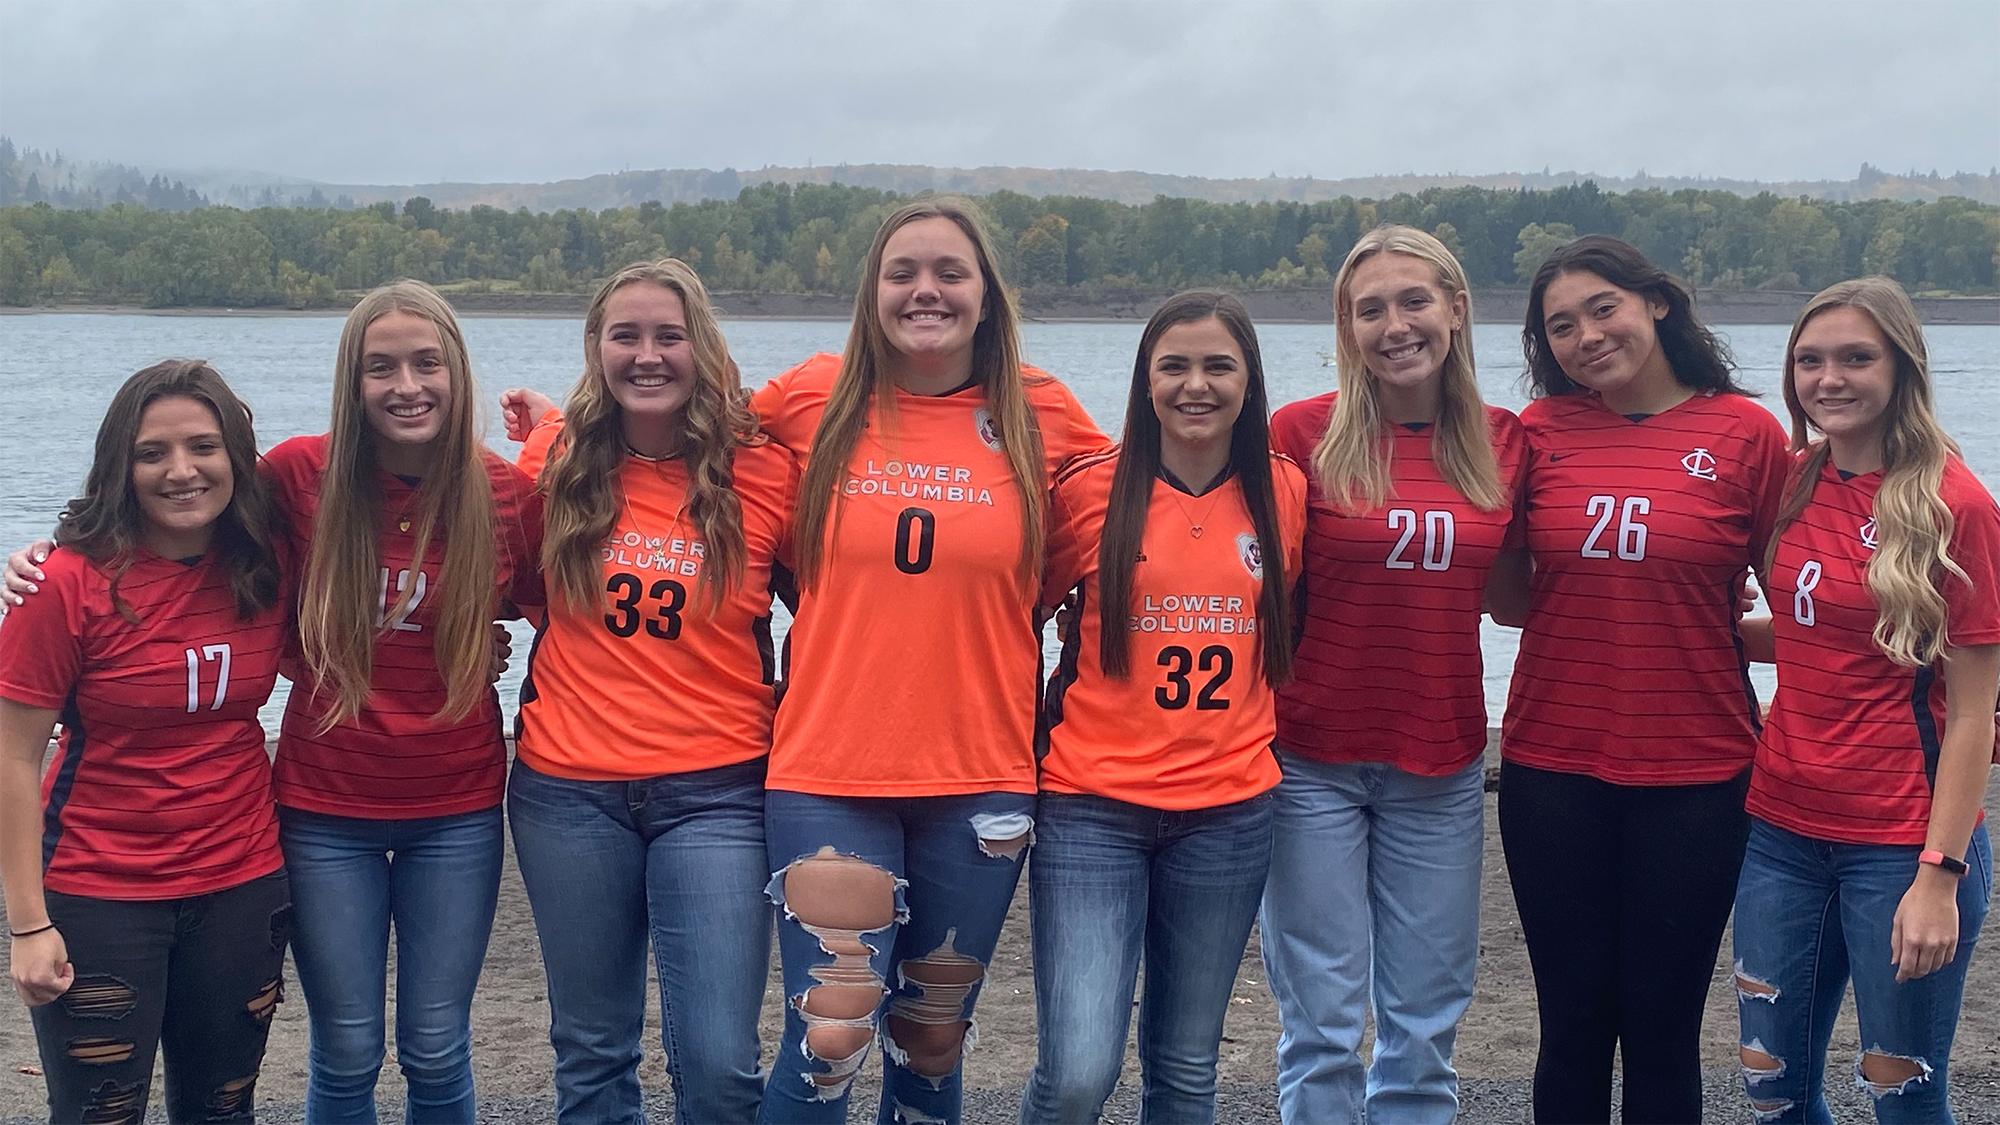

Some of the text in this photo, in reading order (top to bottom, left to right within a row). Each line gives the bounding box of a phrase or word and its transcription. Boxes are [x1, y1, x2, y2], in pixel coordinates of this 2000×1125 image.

[845, 479, 995, 507] COLUMBIA
[867, 460, 972, 483] LOWER
[894, 506, 936, 575] 0
[1385, 508, 1455, 572] 20
[1580, 495, 1651, 562] 26
[601, 547, 699, 577] OLUMB
[1793, 559, 1823, 628] 8
[375, 566, 428, 633] 12
[604, 572, 687, 641] 33
[1144, 594, 1243, 613] LOWER
[185, 643, 232, 714] 17
[1154, 645, 1234, 711] 32
